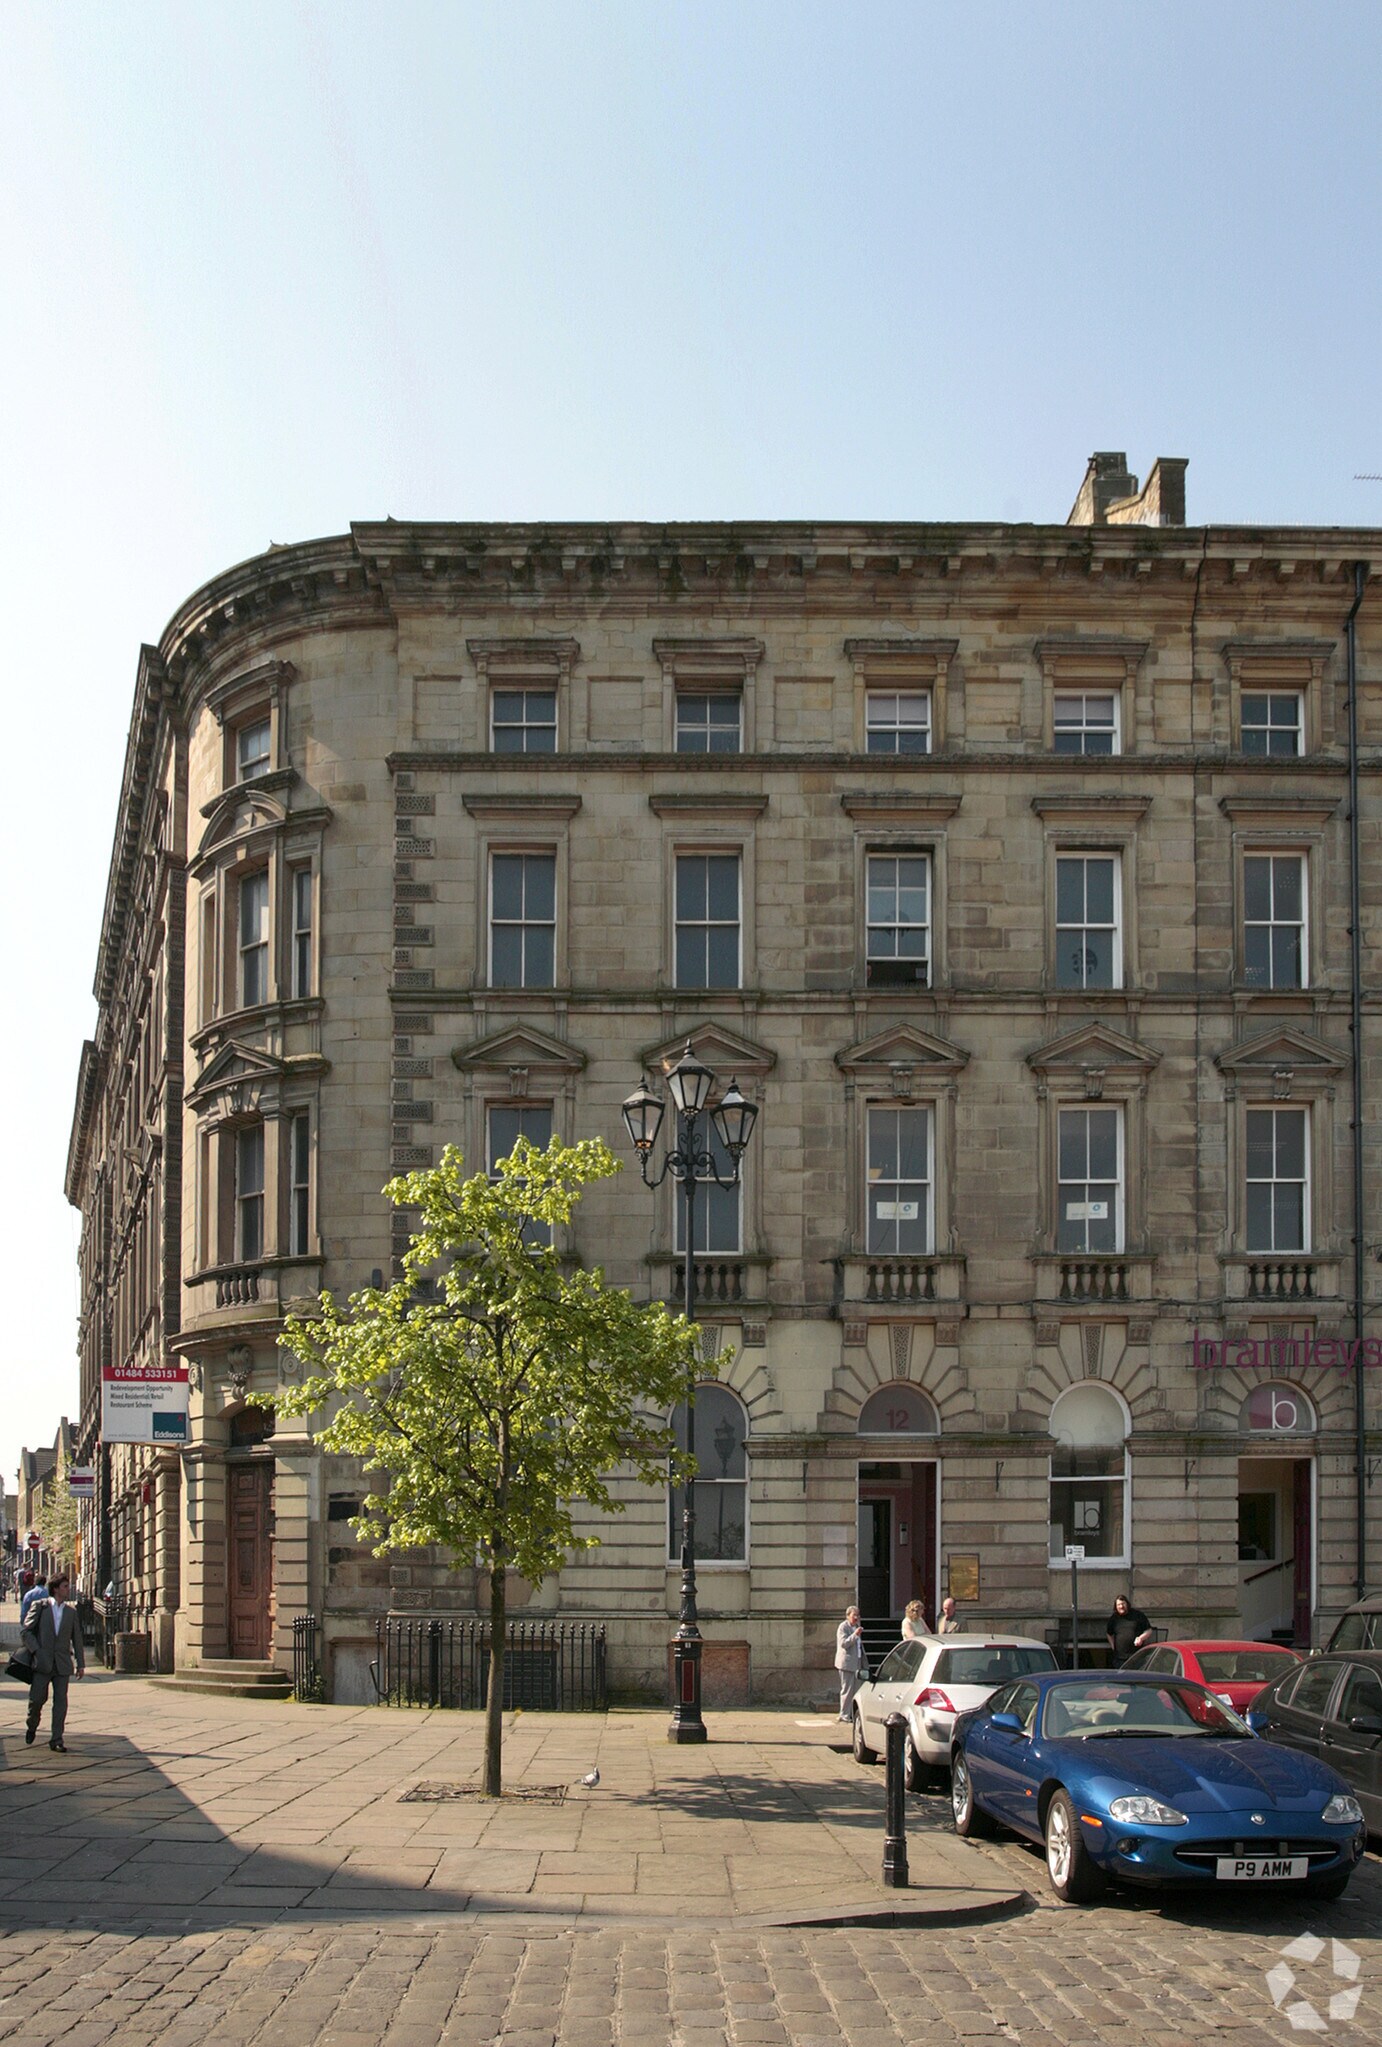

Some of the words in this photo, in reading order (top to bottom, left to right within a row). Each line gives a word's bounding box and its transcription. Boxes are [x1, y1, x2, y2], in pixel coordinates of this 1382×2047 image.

[1193, 1328, 1382, 1377] bramleys
[114, 1369, 143, 1378] 01484
[145, 1369, 177, 1379] 533151
[110, 1384, 145, 1392] Redevelopment
[146, 1384, 173, 1393] Opportunity
[1271, 1391, 1297, 1430] b
[885, 1409, 910, 1430] 12
[154, 1430, 185, 1439] Eddisons
[1234, 1861, 1256, 1877] P9
[1261, 1861, 1292, 1876] AMM
